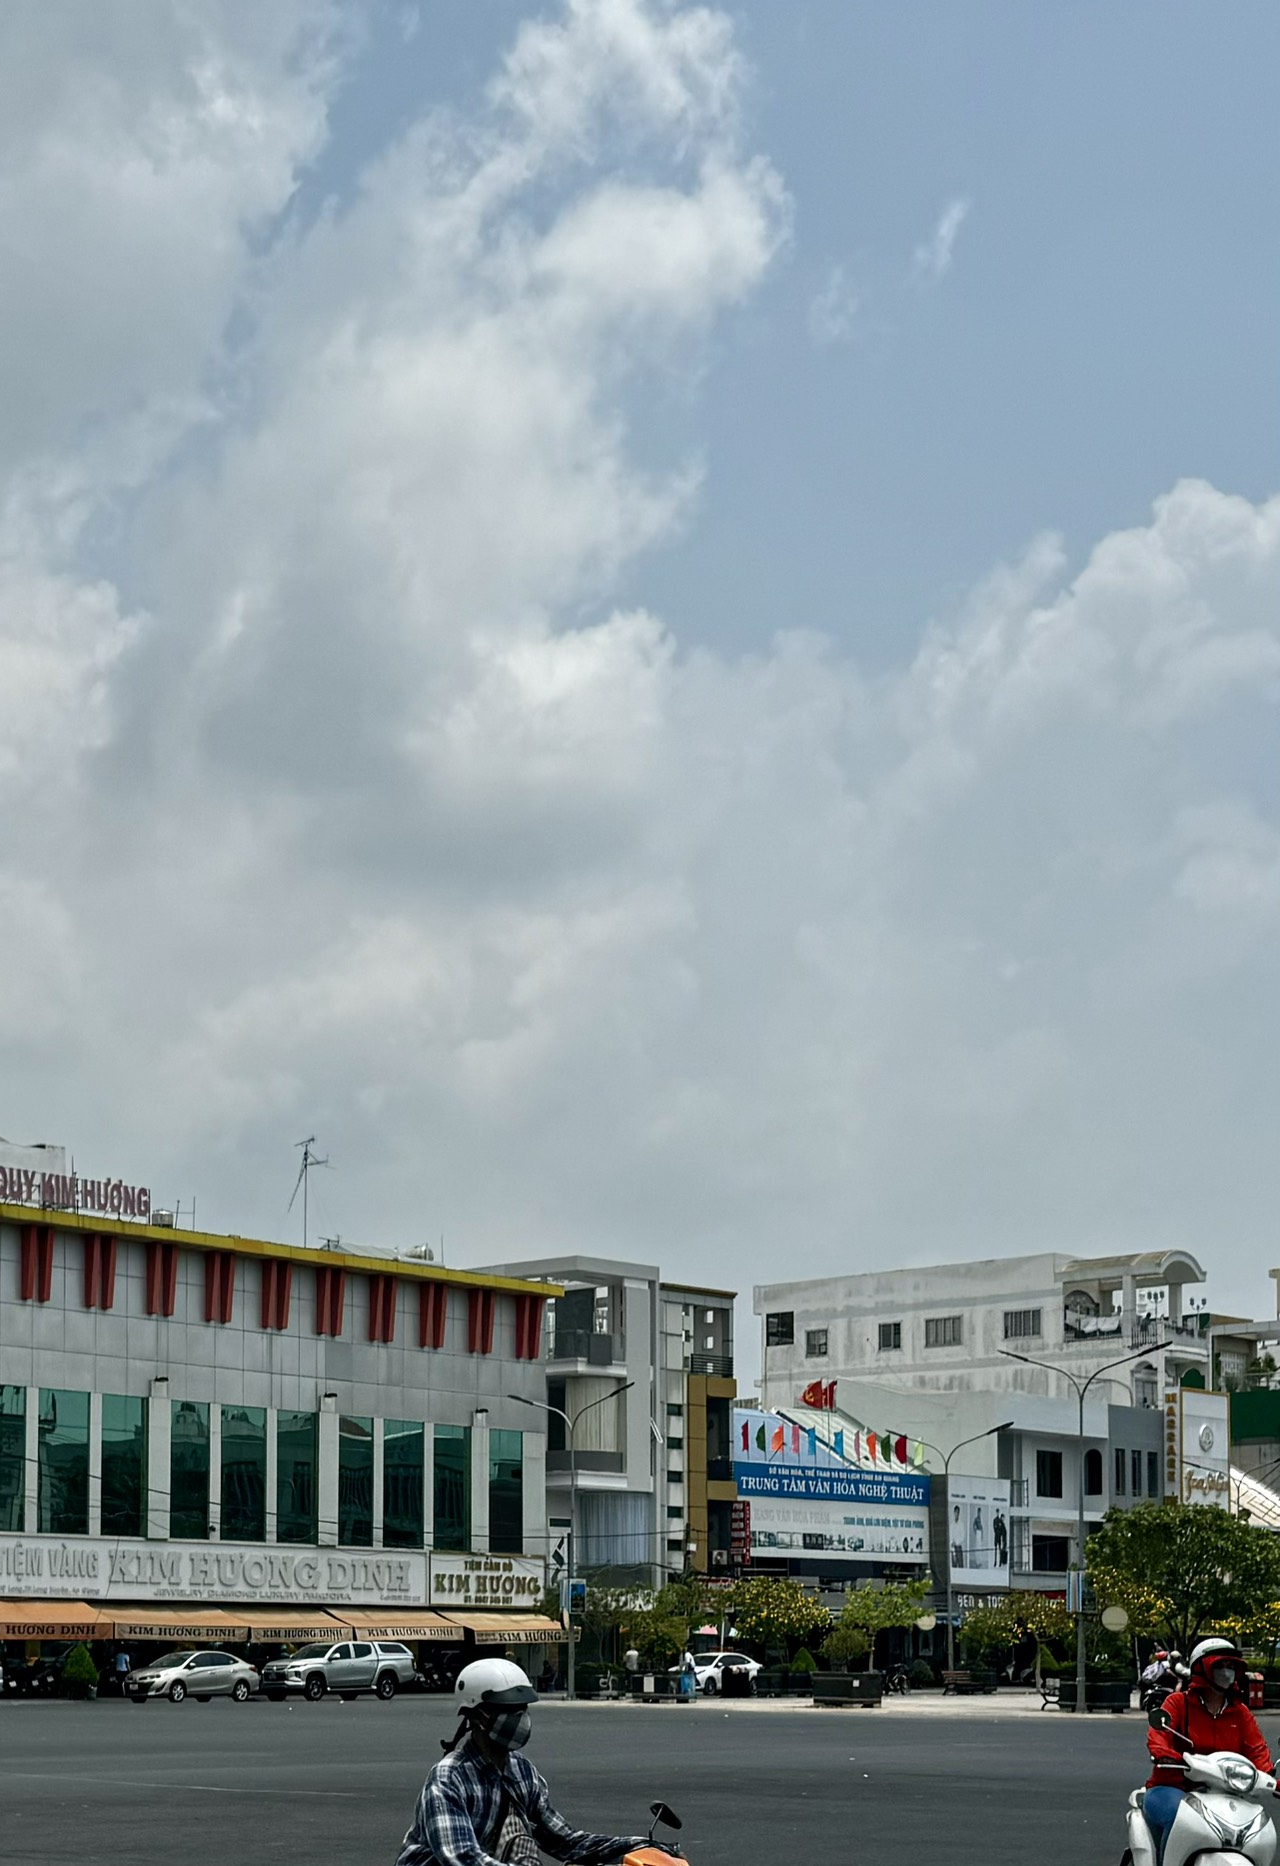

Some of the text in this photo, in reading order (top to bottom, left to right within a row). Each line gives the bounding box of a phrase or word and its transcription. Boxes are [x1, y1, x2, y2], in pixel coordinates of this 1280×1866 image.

[41, 1172, 76, 1206] KIM
[83, 1177, 149, 1217] HƯƠNG
[741, 1476, 924, 1503] TRUNG TÂM VĂN HÓA NGHỆ THUẬT
[48, 1543, 99, 1578] VÀNG
[108, 1549, 183, 1585] KIM
[188, 1551, 321, 1590] HƯƠNG
[327, 1557, 412, 1592] DINH
[434, 1573, 541, 1595] KIM HƯƠNG
[6, 1624, 55, 1635] HƯƠNG
[61, 1625, 96, 1635] DINH
[128, 1626, 236, 1637] KIM HƯƠNG DINH
[263, 1629, 281, 1638] KIM
[319, 1629, 343, 1641] DINH
[368, 1628, 388, 1637] KIM
[430, 1627, 453, 1637] DINH
[498, 1632, 521, 1642] KIM
[525, 1630, 561, 1641] HƯƠNG
